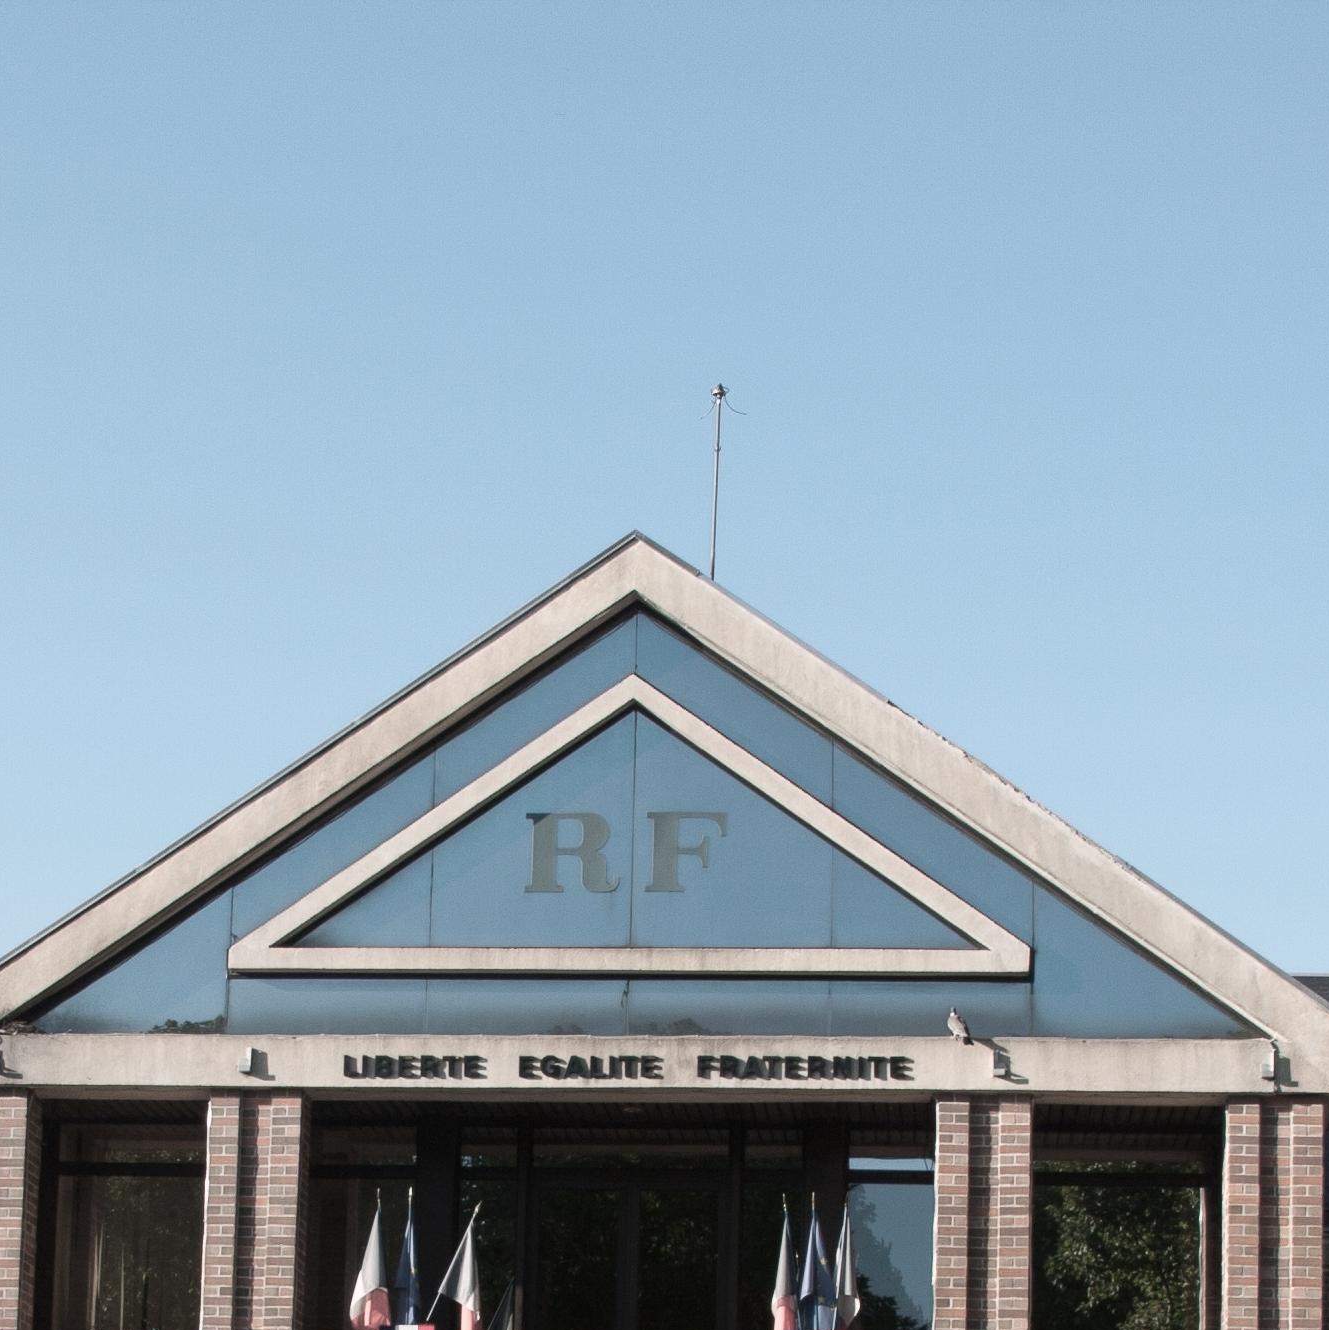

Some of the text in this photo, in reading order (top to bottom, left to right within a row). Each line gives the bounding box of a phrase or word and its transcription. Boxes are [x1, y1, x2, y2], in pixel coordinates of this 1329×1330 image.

[343, 1054, 915, 1081] LIBERTE EGALITE FRATERNITE
